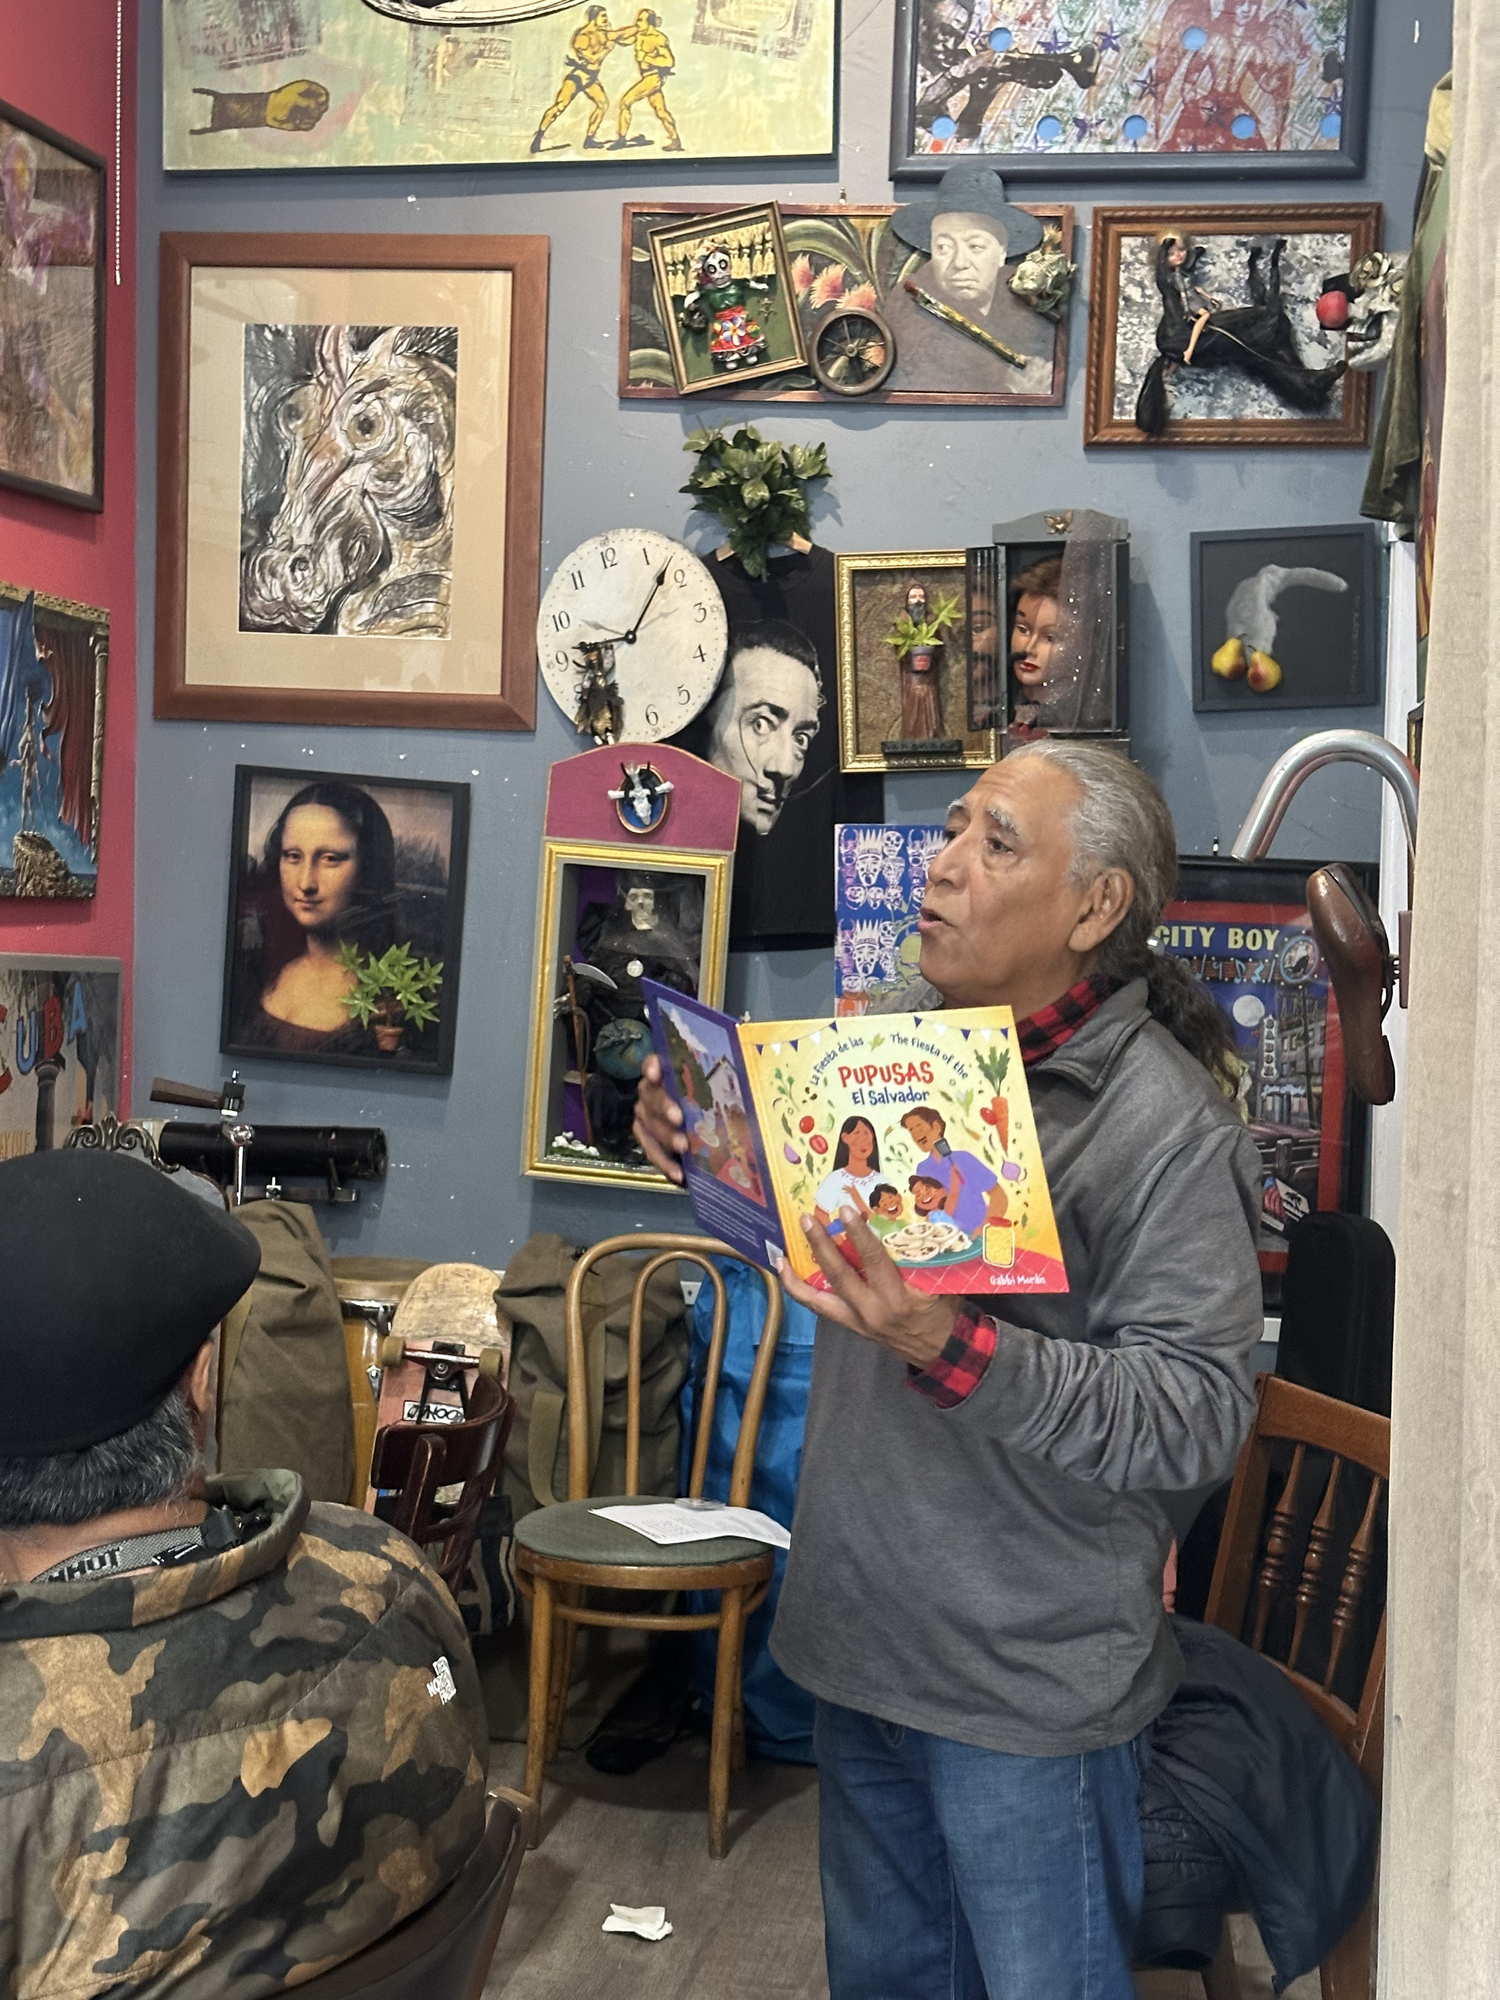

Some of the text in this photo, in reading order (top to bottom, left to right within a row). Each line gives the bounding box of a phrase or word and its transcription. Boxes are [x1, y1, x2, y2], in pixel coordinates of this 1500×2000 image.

[600, 547, 618, 570] 12
[642, 547, 651, 566] 1
[571, 570, 585, 591] 11
[673, 568, 687, 588] 2
[552, 610, 571, 632] 10
[693, 602, 707, 623] 3
[555, 650, 569, 672] 9
[692, 644, 707, 663] 4
[677, 684, 691, 705] 5
[645, 704, 659, 726] 6
[1154, 924, 1280, 951] CITY BOY
[809, 1074, 820, 1086] La
[837, 1042, 850, 1053] de
[848, 1036, 864, 1049] las
[889, 1031, 909, 1046] The
[942, 1053, 955, 1065] of
[953, 1060, 969, 1080] the
[838, 1060, 935, 1088] PUPUSAS
[851, 1085, 931, 1106] El Salvador
[990, 1274, 1016, 1286] Gabbi
